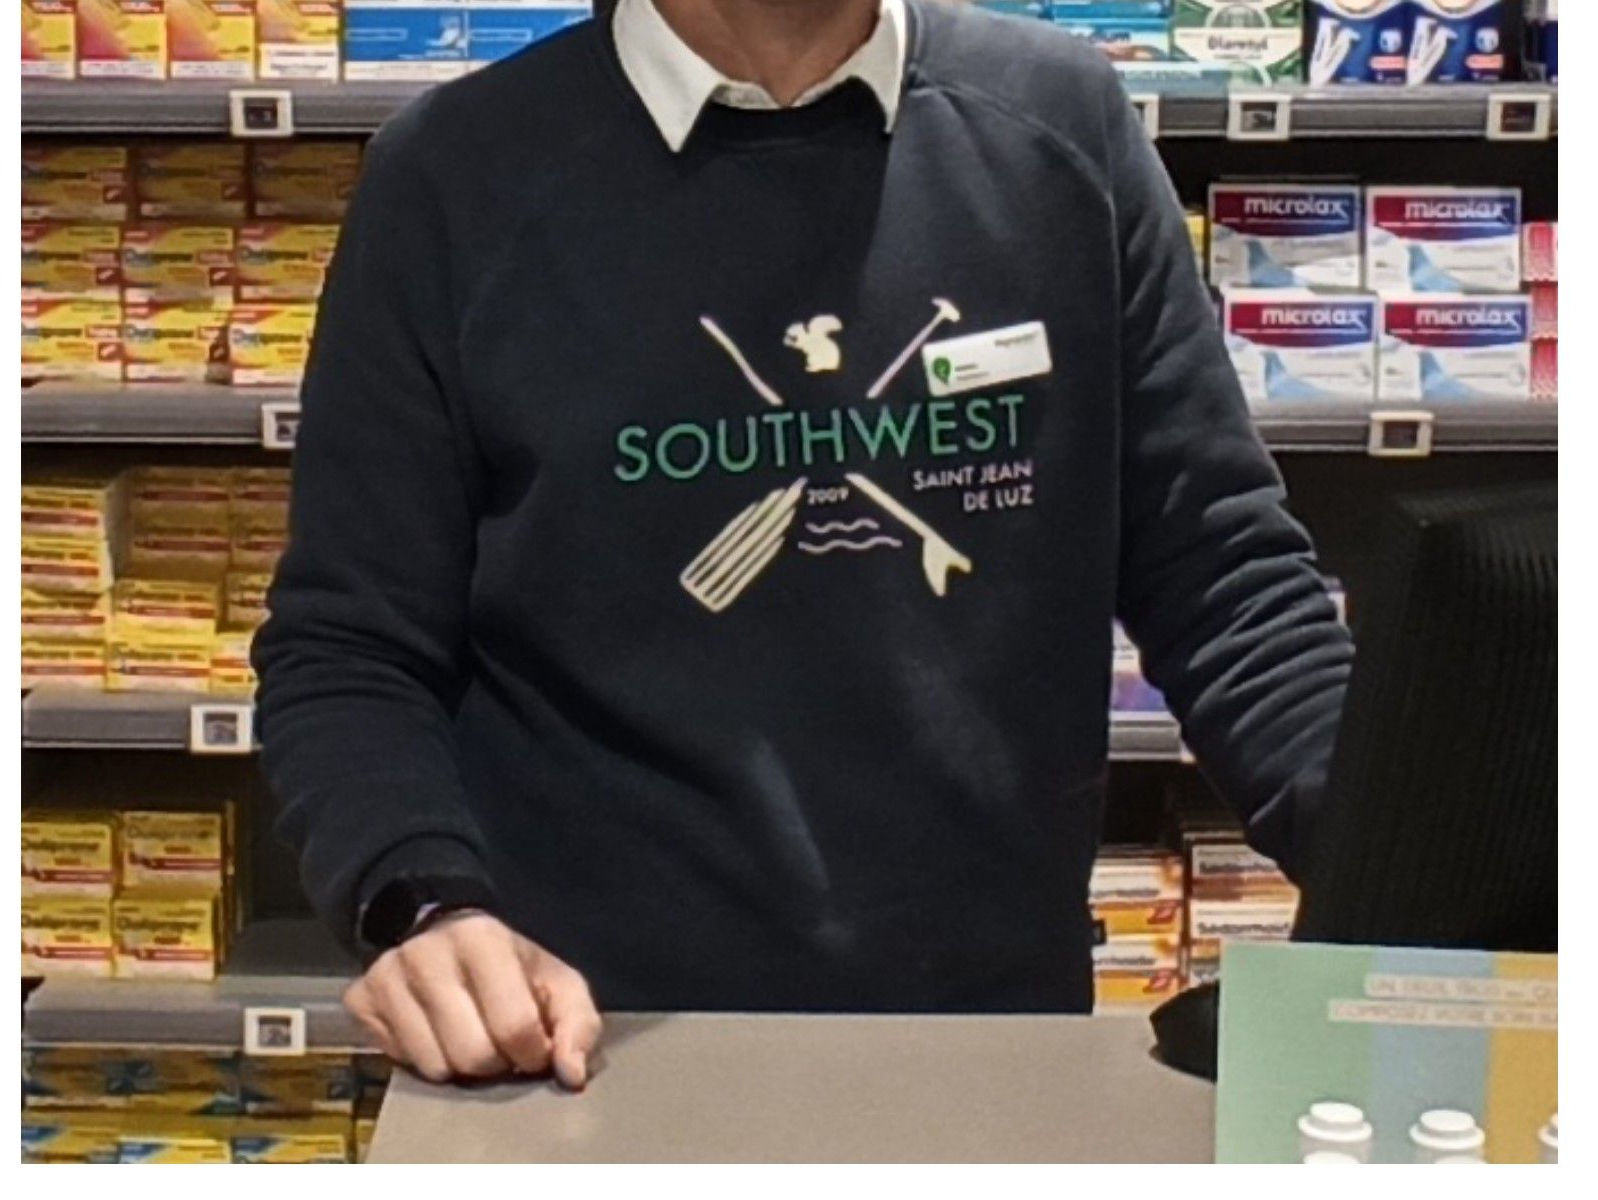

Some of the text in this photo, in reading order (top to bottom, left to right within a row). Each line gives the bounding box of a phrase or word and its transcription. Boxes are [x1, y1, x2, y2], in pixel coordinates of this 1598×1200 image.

[1244, 197, 1348, 218] microlax
[1405, 198, 1510, 219] microlax
[1261, 306, 1366, 327] microlax
[1415, 306, 1521, 327] microlax
[614, 395, 1026, 482] SOUTHWEST
[913, 460, 1032, 490] SAINT JEAN
[807, 487, 850, 505] 2009
[963, 486, 1033, 512] DE LUZ
